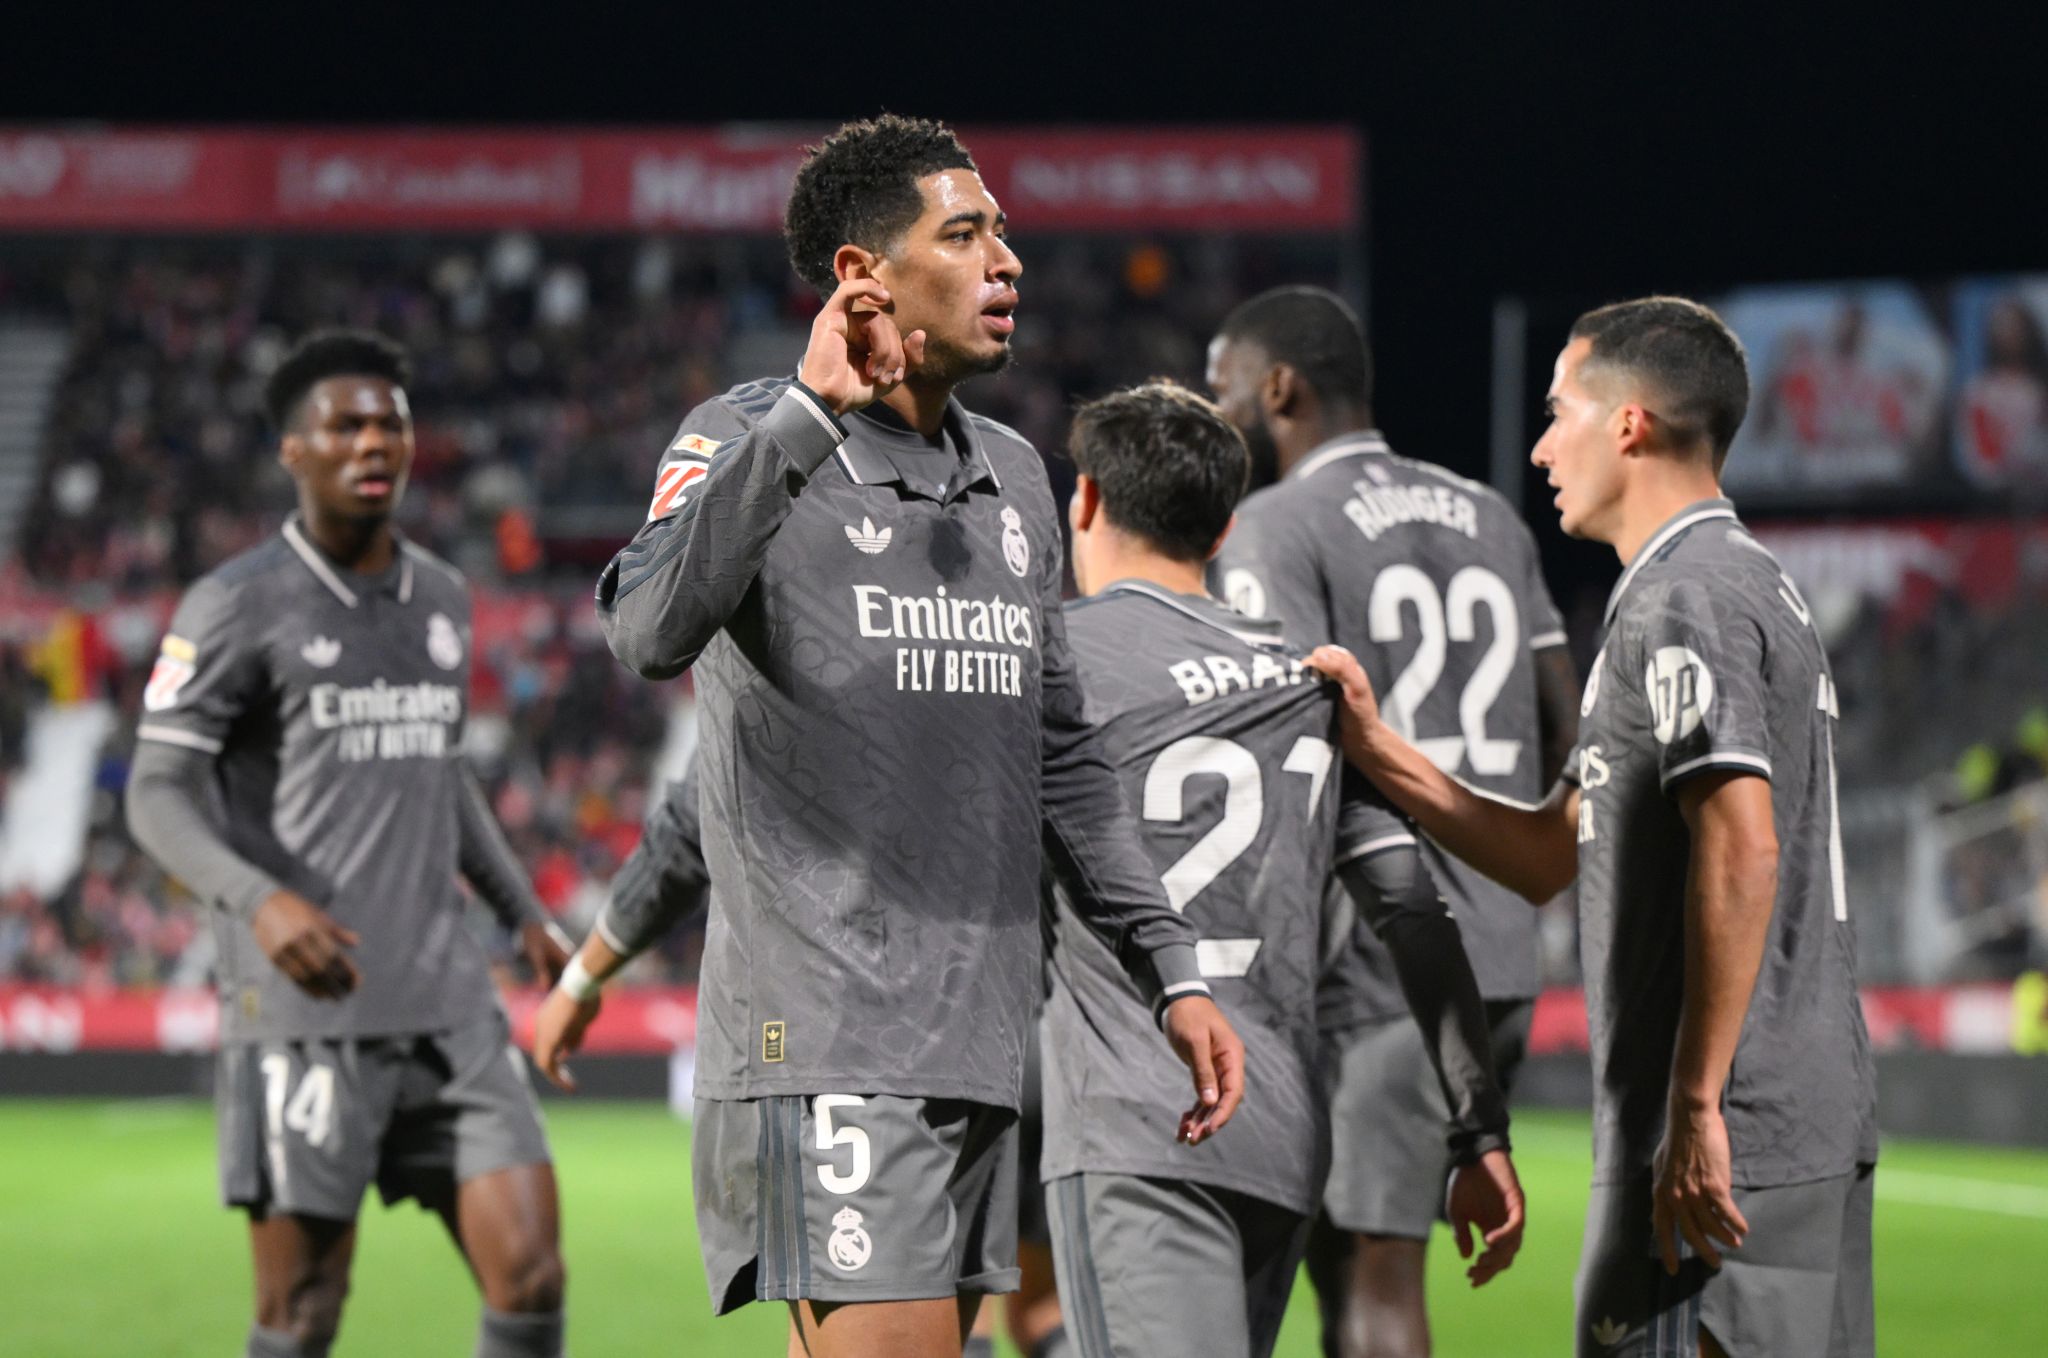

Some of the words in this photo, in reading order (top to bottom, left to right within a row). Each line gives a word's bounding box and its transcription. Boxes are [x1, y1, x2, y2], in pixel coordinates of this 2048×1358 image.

[852, 584, 1033, 648] Emirates
[310, 677, 461, 729] Emirates
[896, 648, 936, 692] FLY
[945, 650, 1022, 697] BETTER
[1369, 564, 1522, 776] 22
[260, 1054, 334, 1148] 14
[814, 1094, 871, 1195] 5
